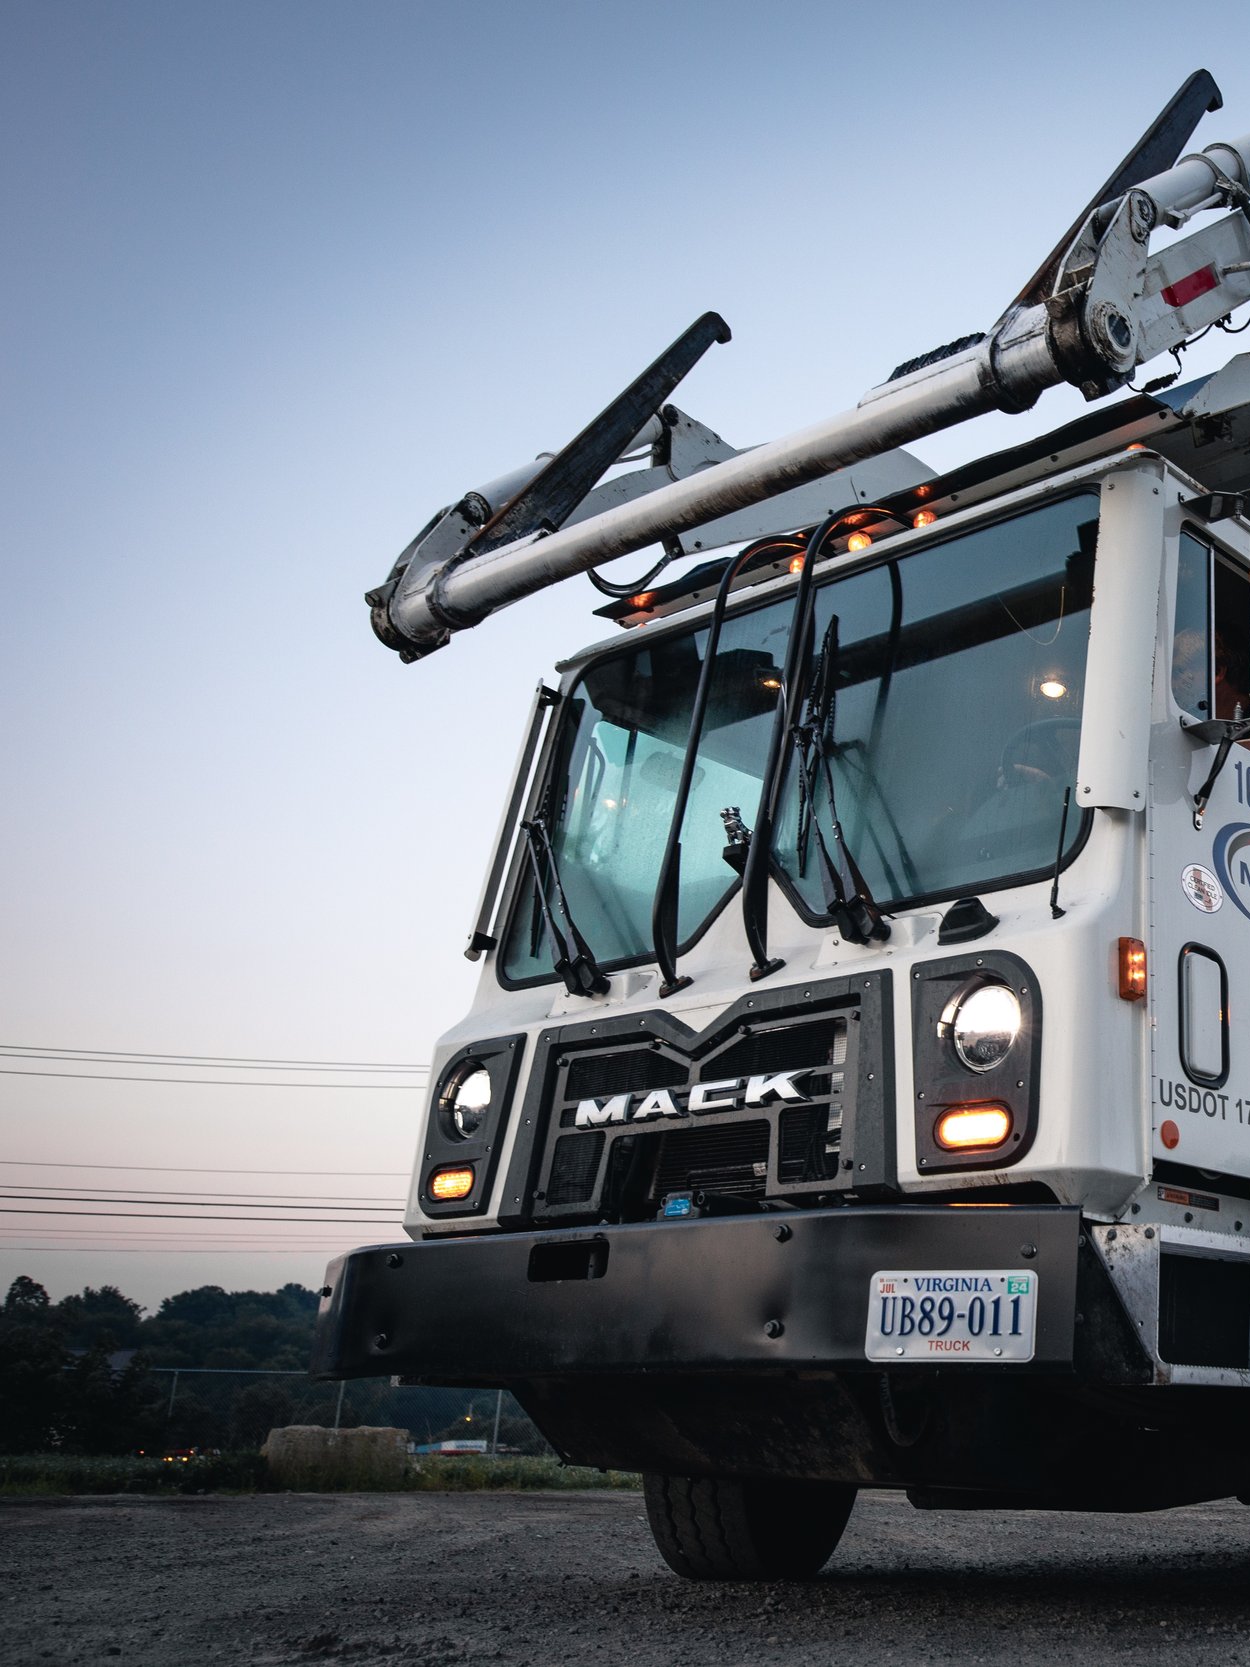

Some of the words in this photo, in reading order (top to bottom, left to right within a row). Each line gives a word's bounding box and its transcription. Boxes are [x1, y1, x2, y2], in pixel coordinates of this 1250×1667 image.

[575, 1068, 815, 1130] MACK
[1159, 1078, 1229, 1121] USDOT
[880, 1283, 896, 1294] JUL
[914, 1277, 993, 1292] VIRGINIA
[1011, 1282, 1028, 1293] 24
[880, 1295, 1022, 1336] UB89-011
[927, 1340, 971, 1351] TRUCK
